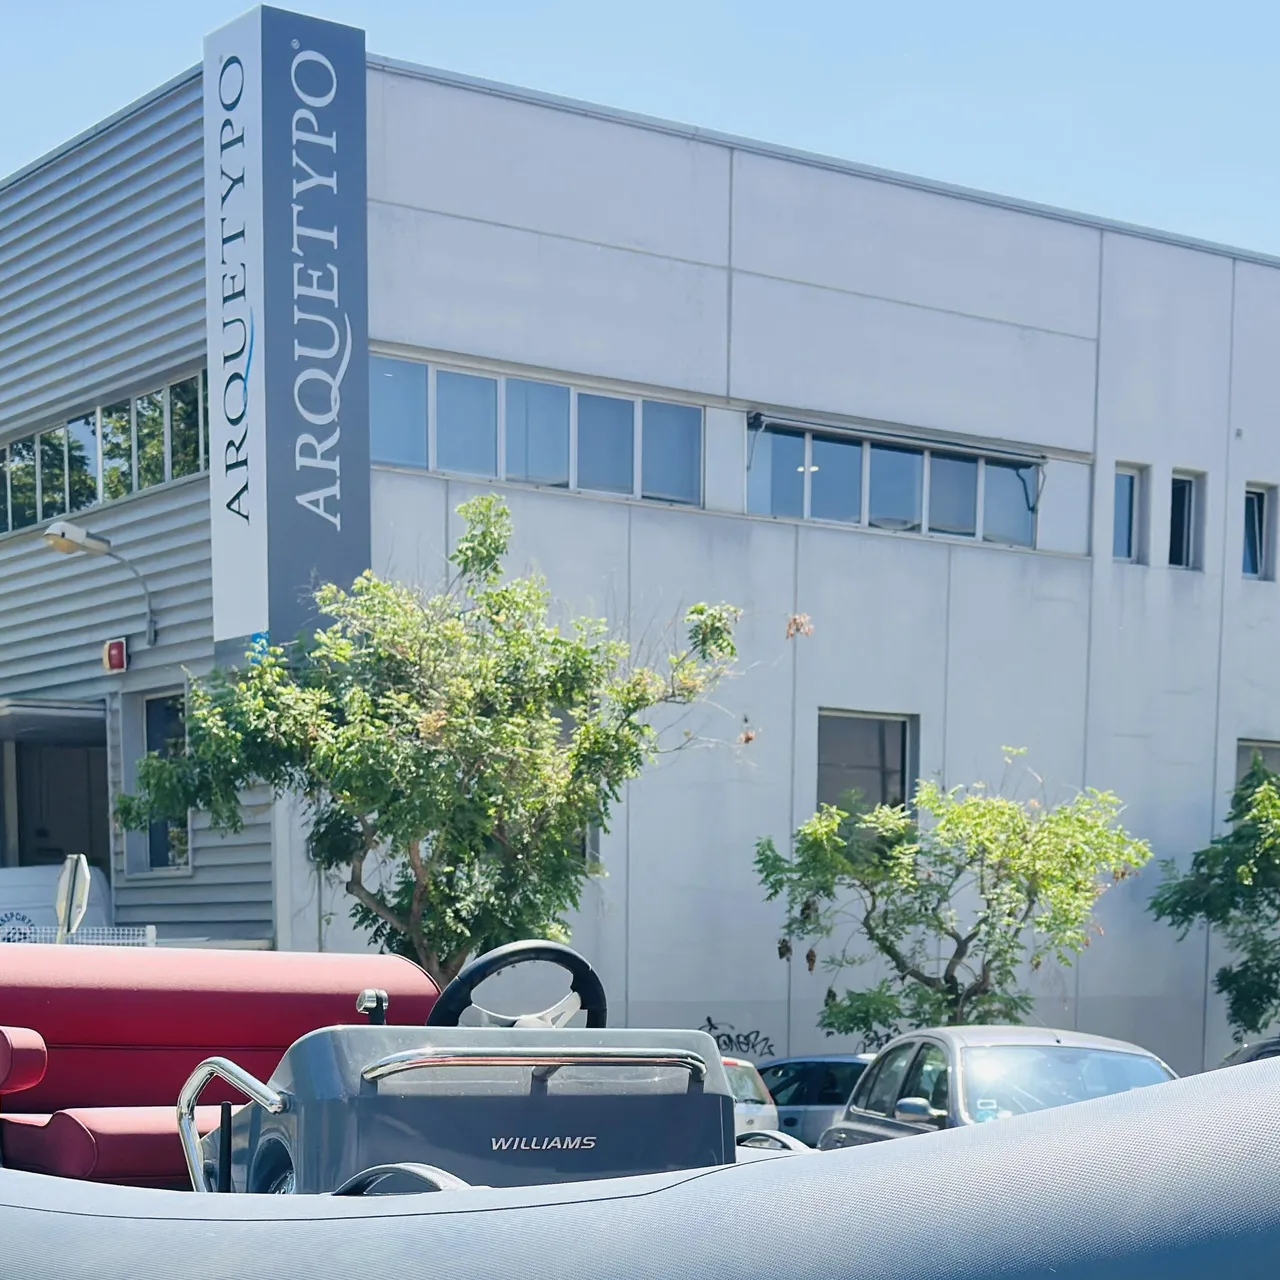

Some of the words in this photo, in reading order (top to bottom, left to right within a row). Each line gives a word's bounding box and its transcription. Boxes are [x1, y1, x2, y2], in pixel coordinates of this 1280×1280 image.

[219, 54, 254, 526] ARQUETYPO
[290, 49, 352, 532] ARQUETYPO
[491, 1136, 597, 1150] WILLIAMS
